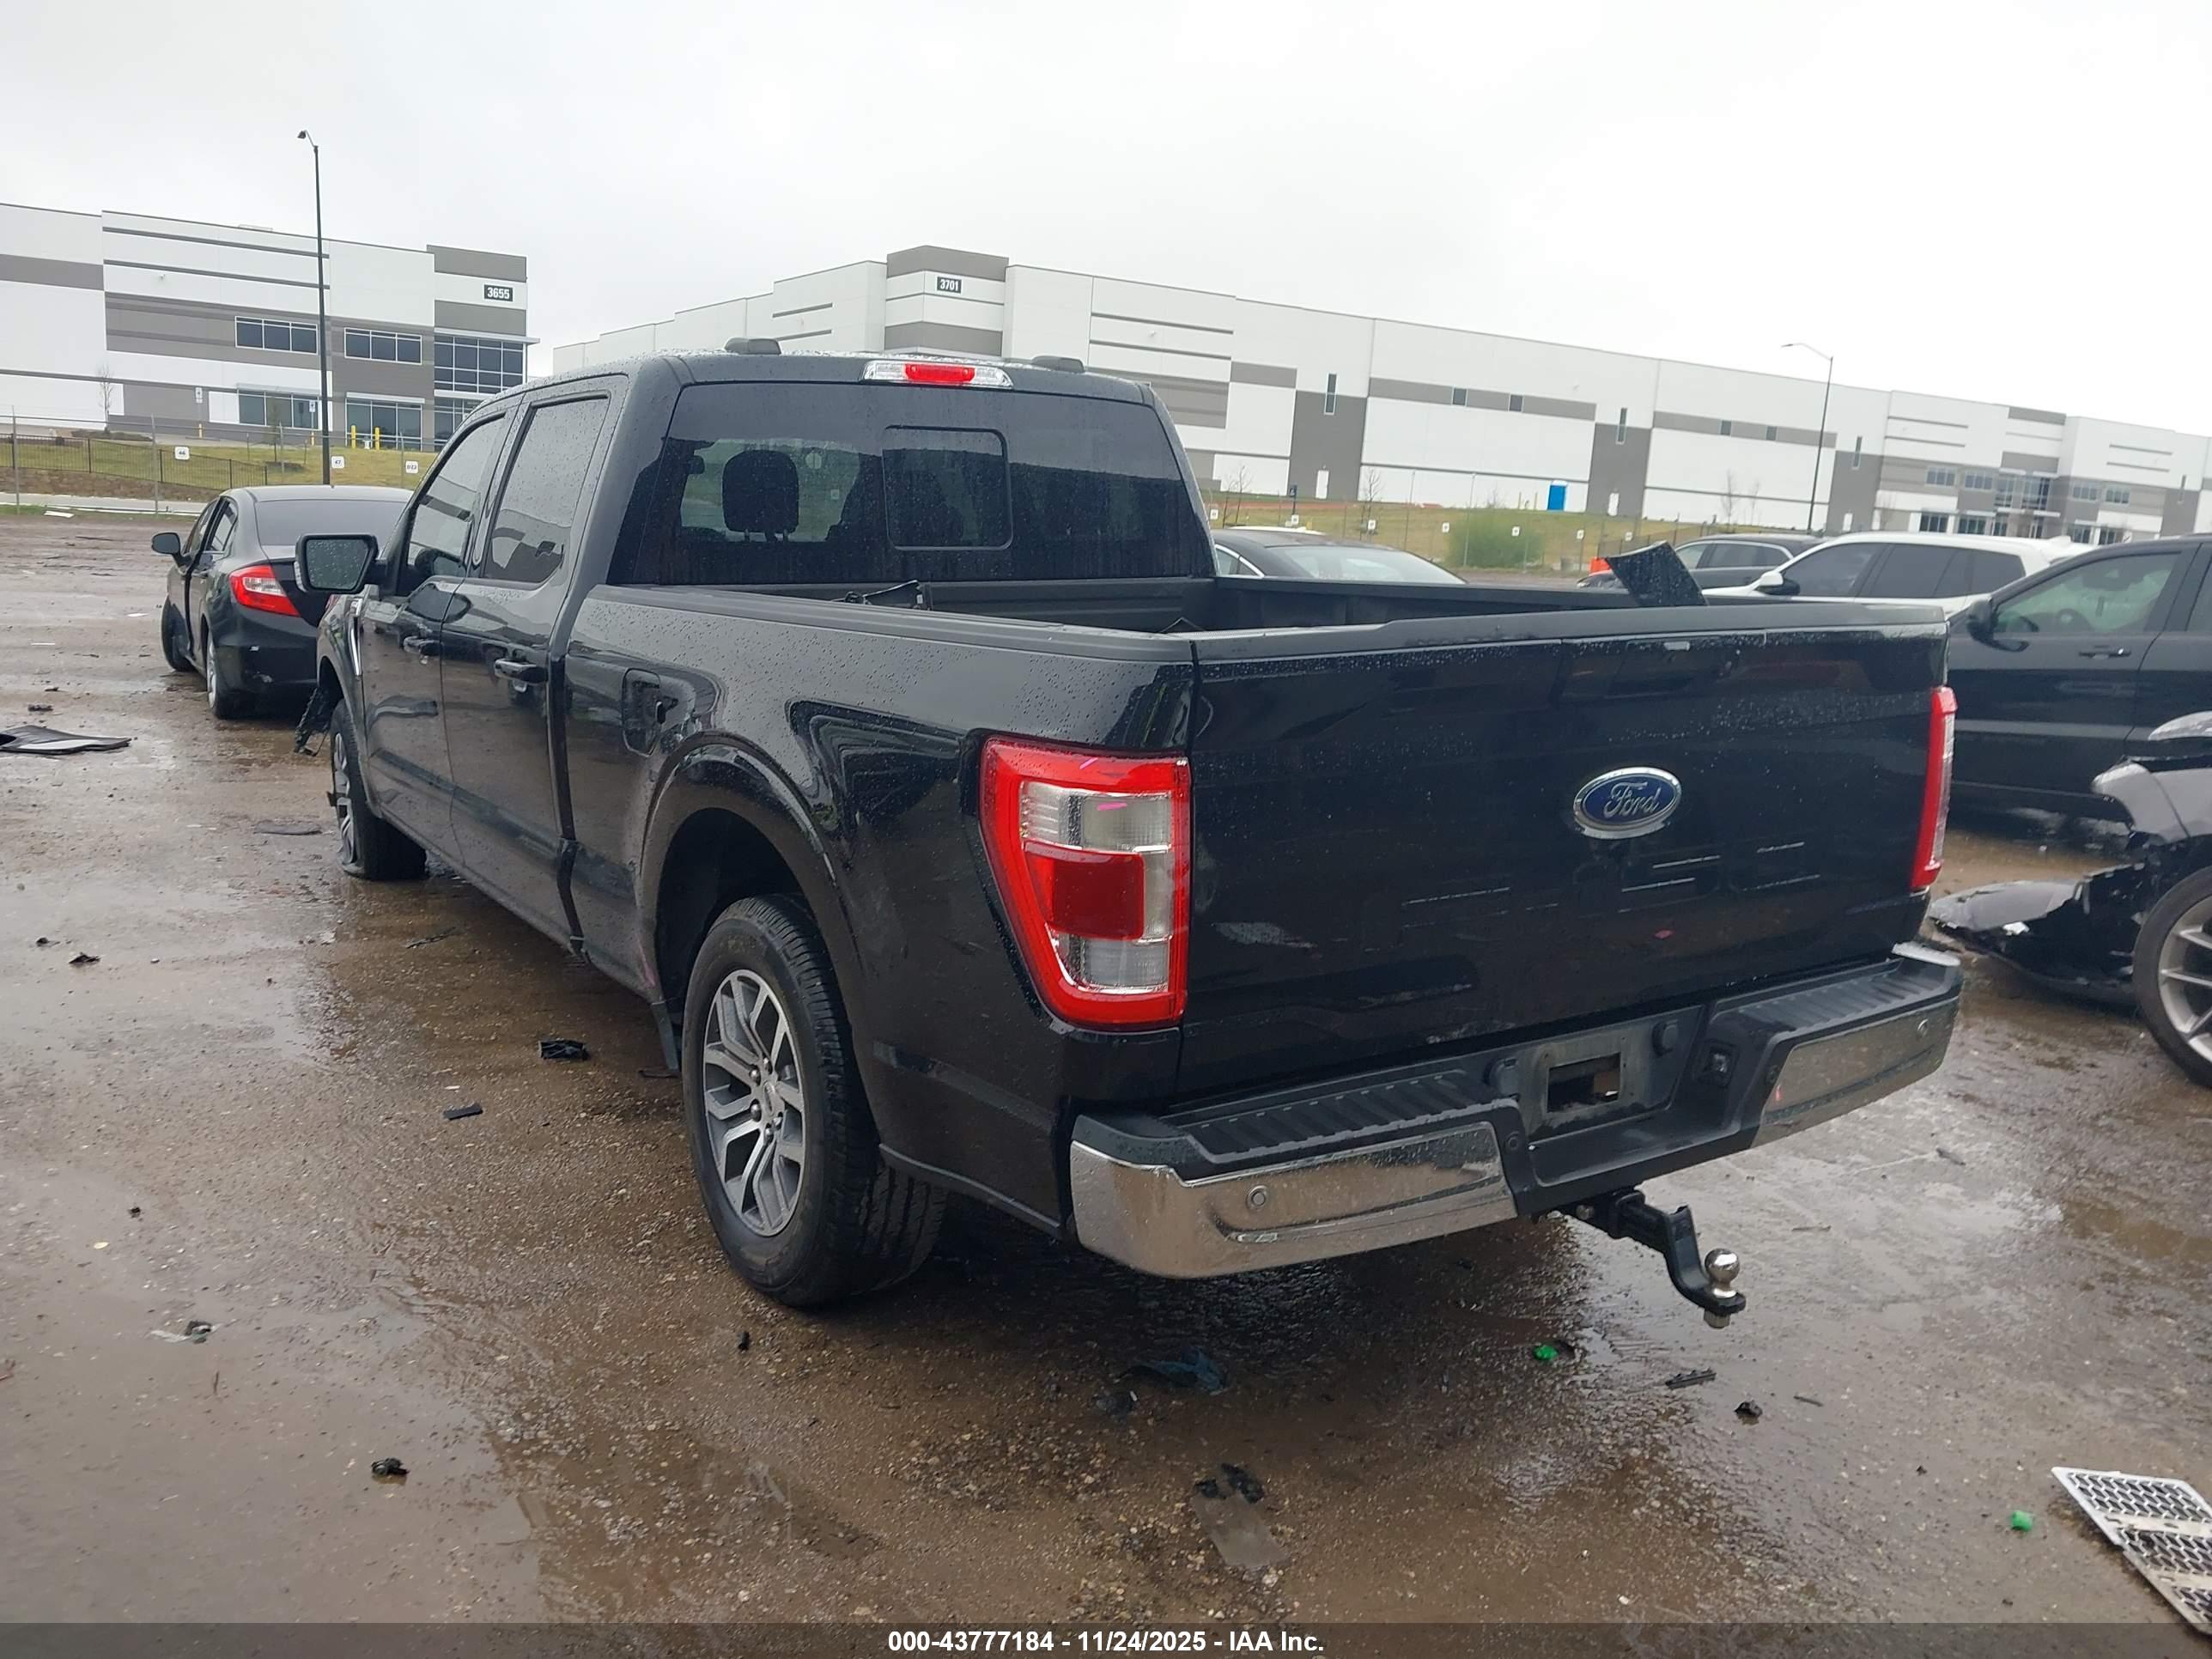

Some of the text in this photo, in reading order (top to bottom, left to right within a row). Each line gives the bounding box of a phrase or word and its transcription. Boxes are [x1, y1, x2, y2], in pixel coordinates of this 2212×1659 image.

[939, 278, 958, 291] 3701
[487, 287, 510, 299] 3655
[1603, 781, 1662, 818] Ford
